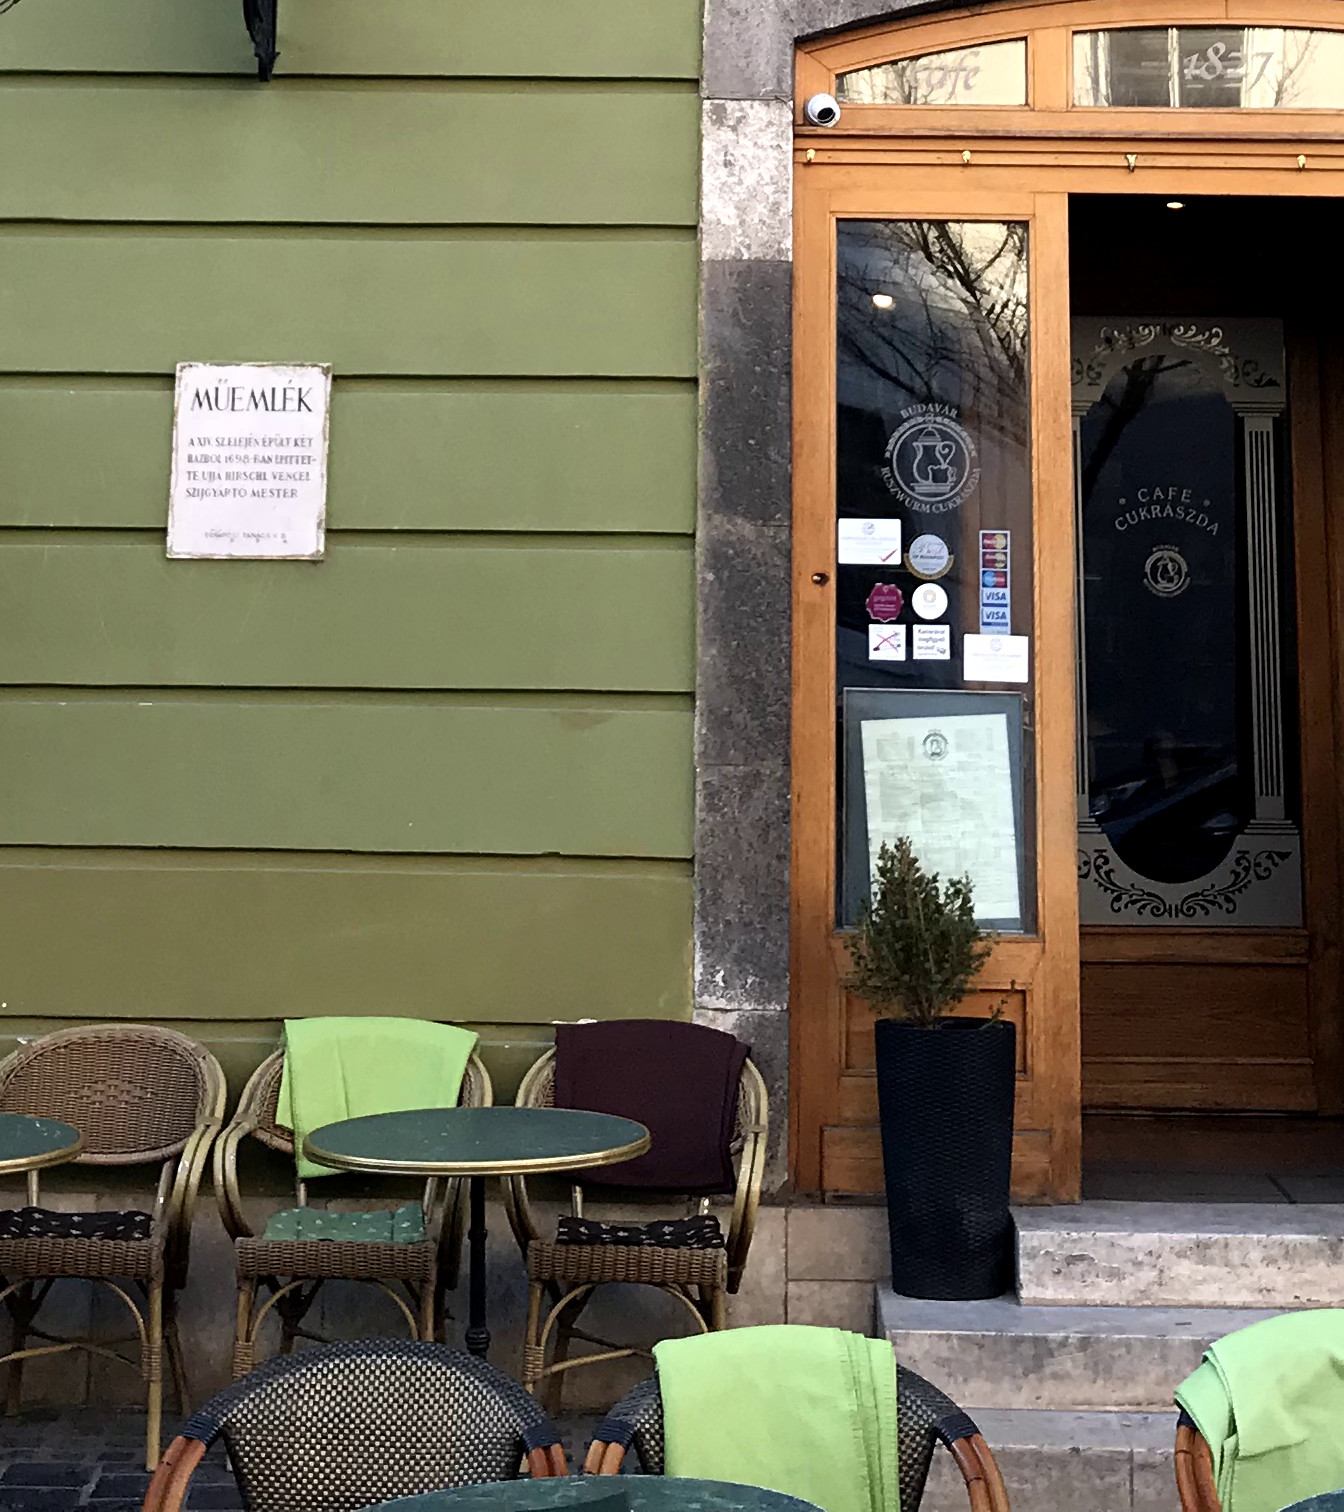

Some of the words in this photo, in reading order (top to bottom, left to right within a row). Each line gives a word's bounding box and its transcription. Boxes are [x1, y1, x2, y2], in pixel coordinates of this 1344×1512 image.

[1183, 41, 1276, 92] 1827
[190, 378, 313, 412] MŰEMLÉK
[900, 402, 958, 418] BUDAVÁR
[188, 437, 195, 447] A
[187, 470, 199, 481] TE
[881, 467, 931, 513] RUSZWURM
[1137, 487, 1192, 503] CAFE
[1115, 501, 1219, 536] CUKRÁSZDA
[985, 592, 1007, 601] VISA
[985, 611, 1007, 620] VISA
